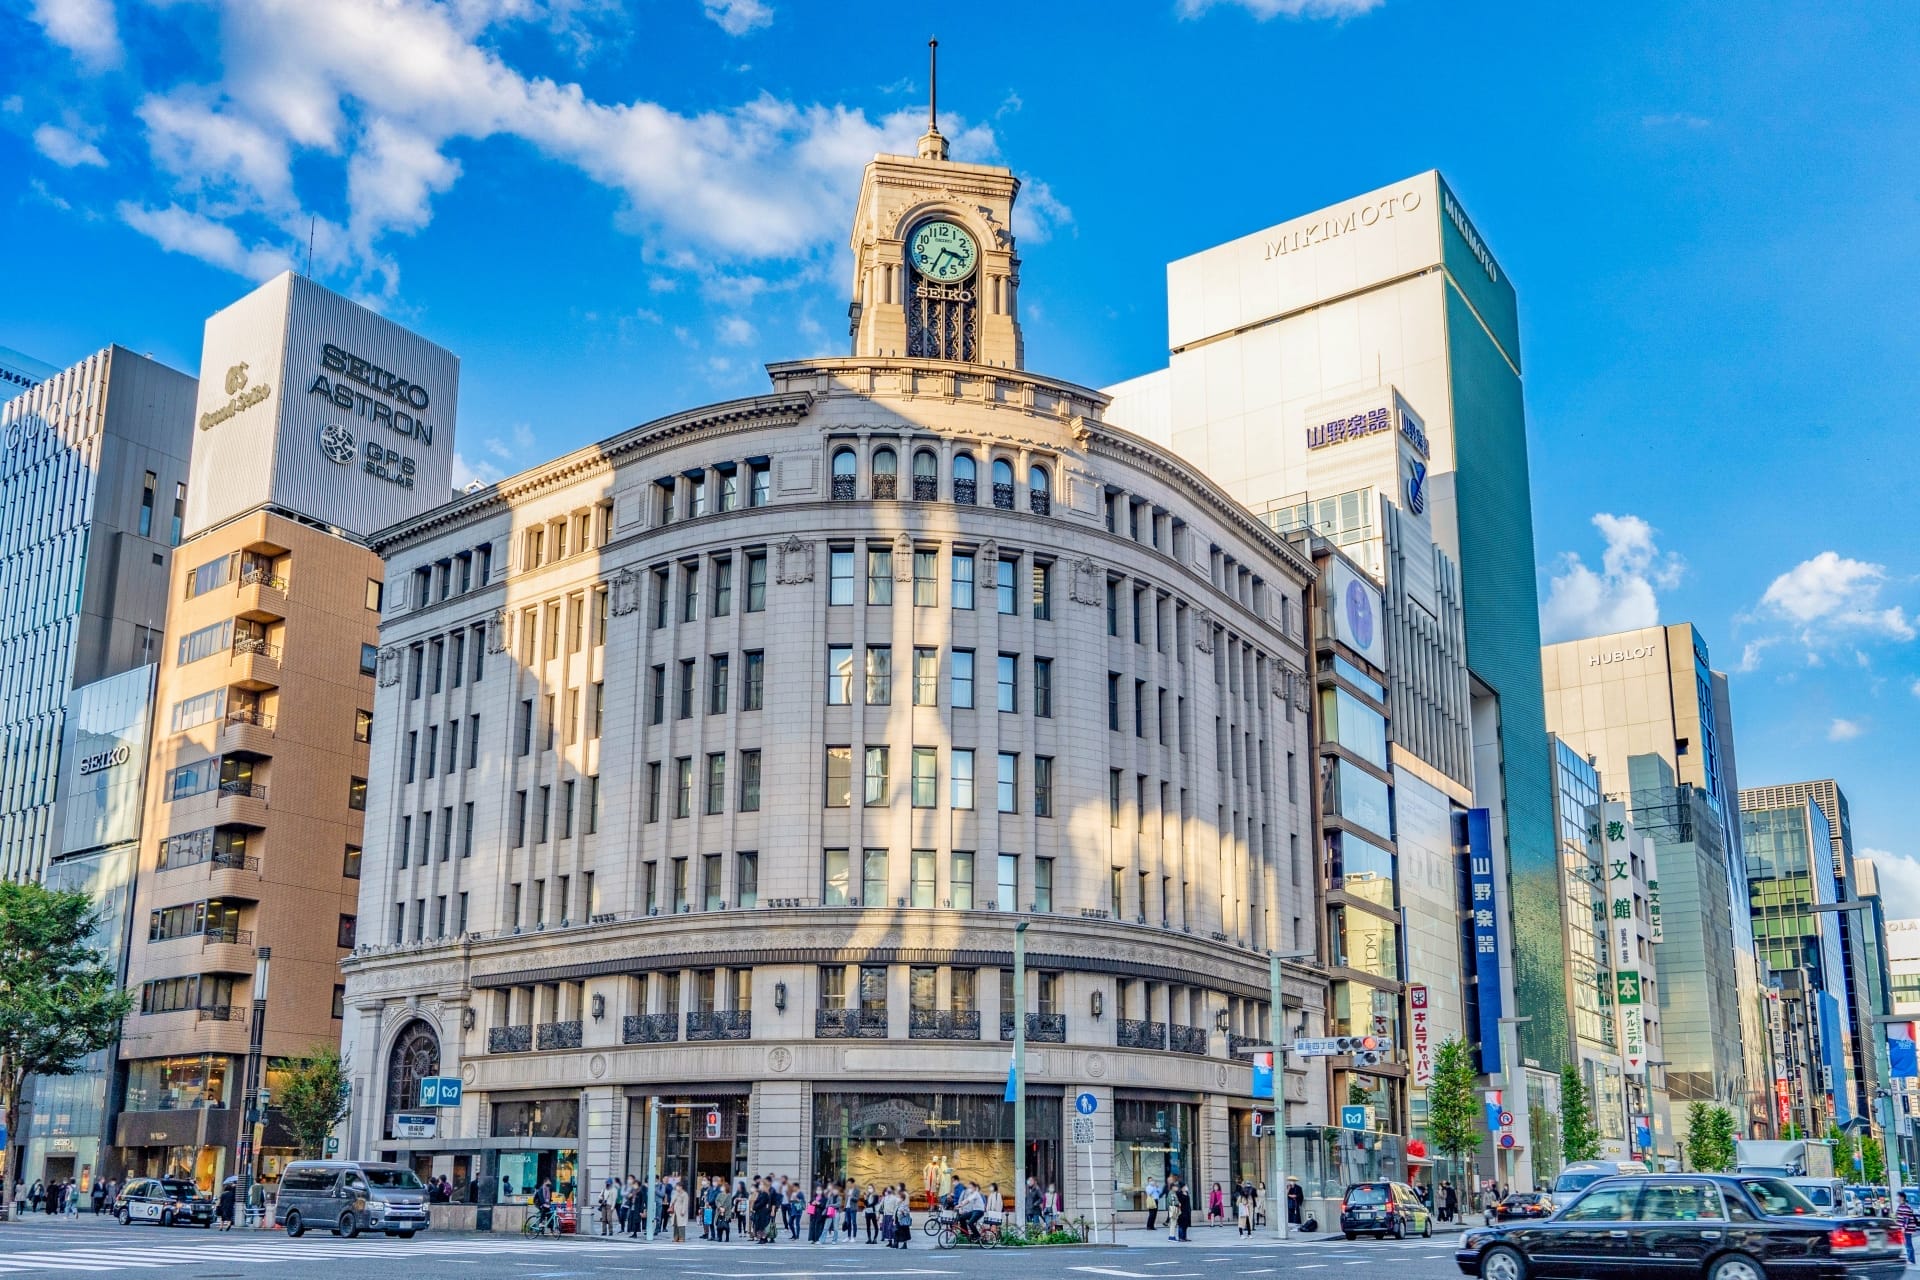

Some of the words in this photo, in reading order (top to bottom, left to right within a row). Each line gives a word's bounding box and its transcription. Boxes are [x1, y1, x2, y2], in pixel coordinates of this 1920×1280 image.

[1264, 191, 1421, 260] MIKIMOTO
[1445, 191, 1497, 282] MIKIMOTO
[917, 286, 971, 301] SEIKO
[321, 343, 430, 411] SEIKO
[308, 375, 433, 447] ASTRON
[1306, 407, 1388, 449] 山野楽器
[364, 461, 414, 491] SOLAR
[366, 441, 415, 476] GPS
[1589, 645, 1655, 667] HUBLOT
[80, 746, 129, 775] SEIKO
[1607, 820, 1631, 920] 教文館
[1473, 857, 1495, 953] 山野楽器
[1648, 880, 1662, 938] 教文館ビル
[1618, 976, 1638, 999] 本
[1414, 1012, 1430, 1082] キムラヤのパン
[1625, 1009, 1638, 1054] ナルニア国
